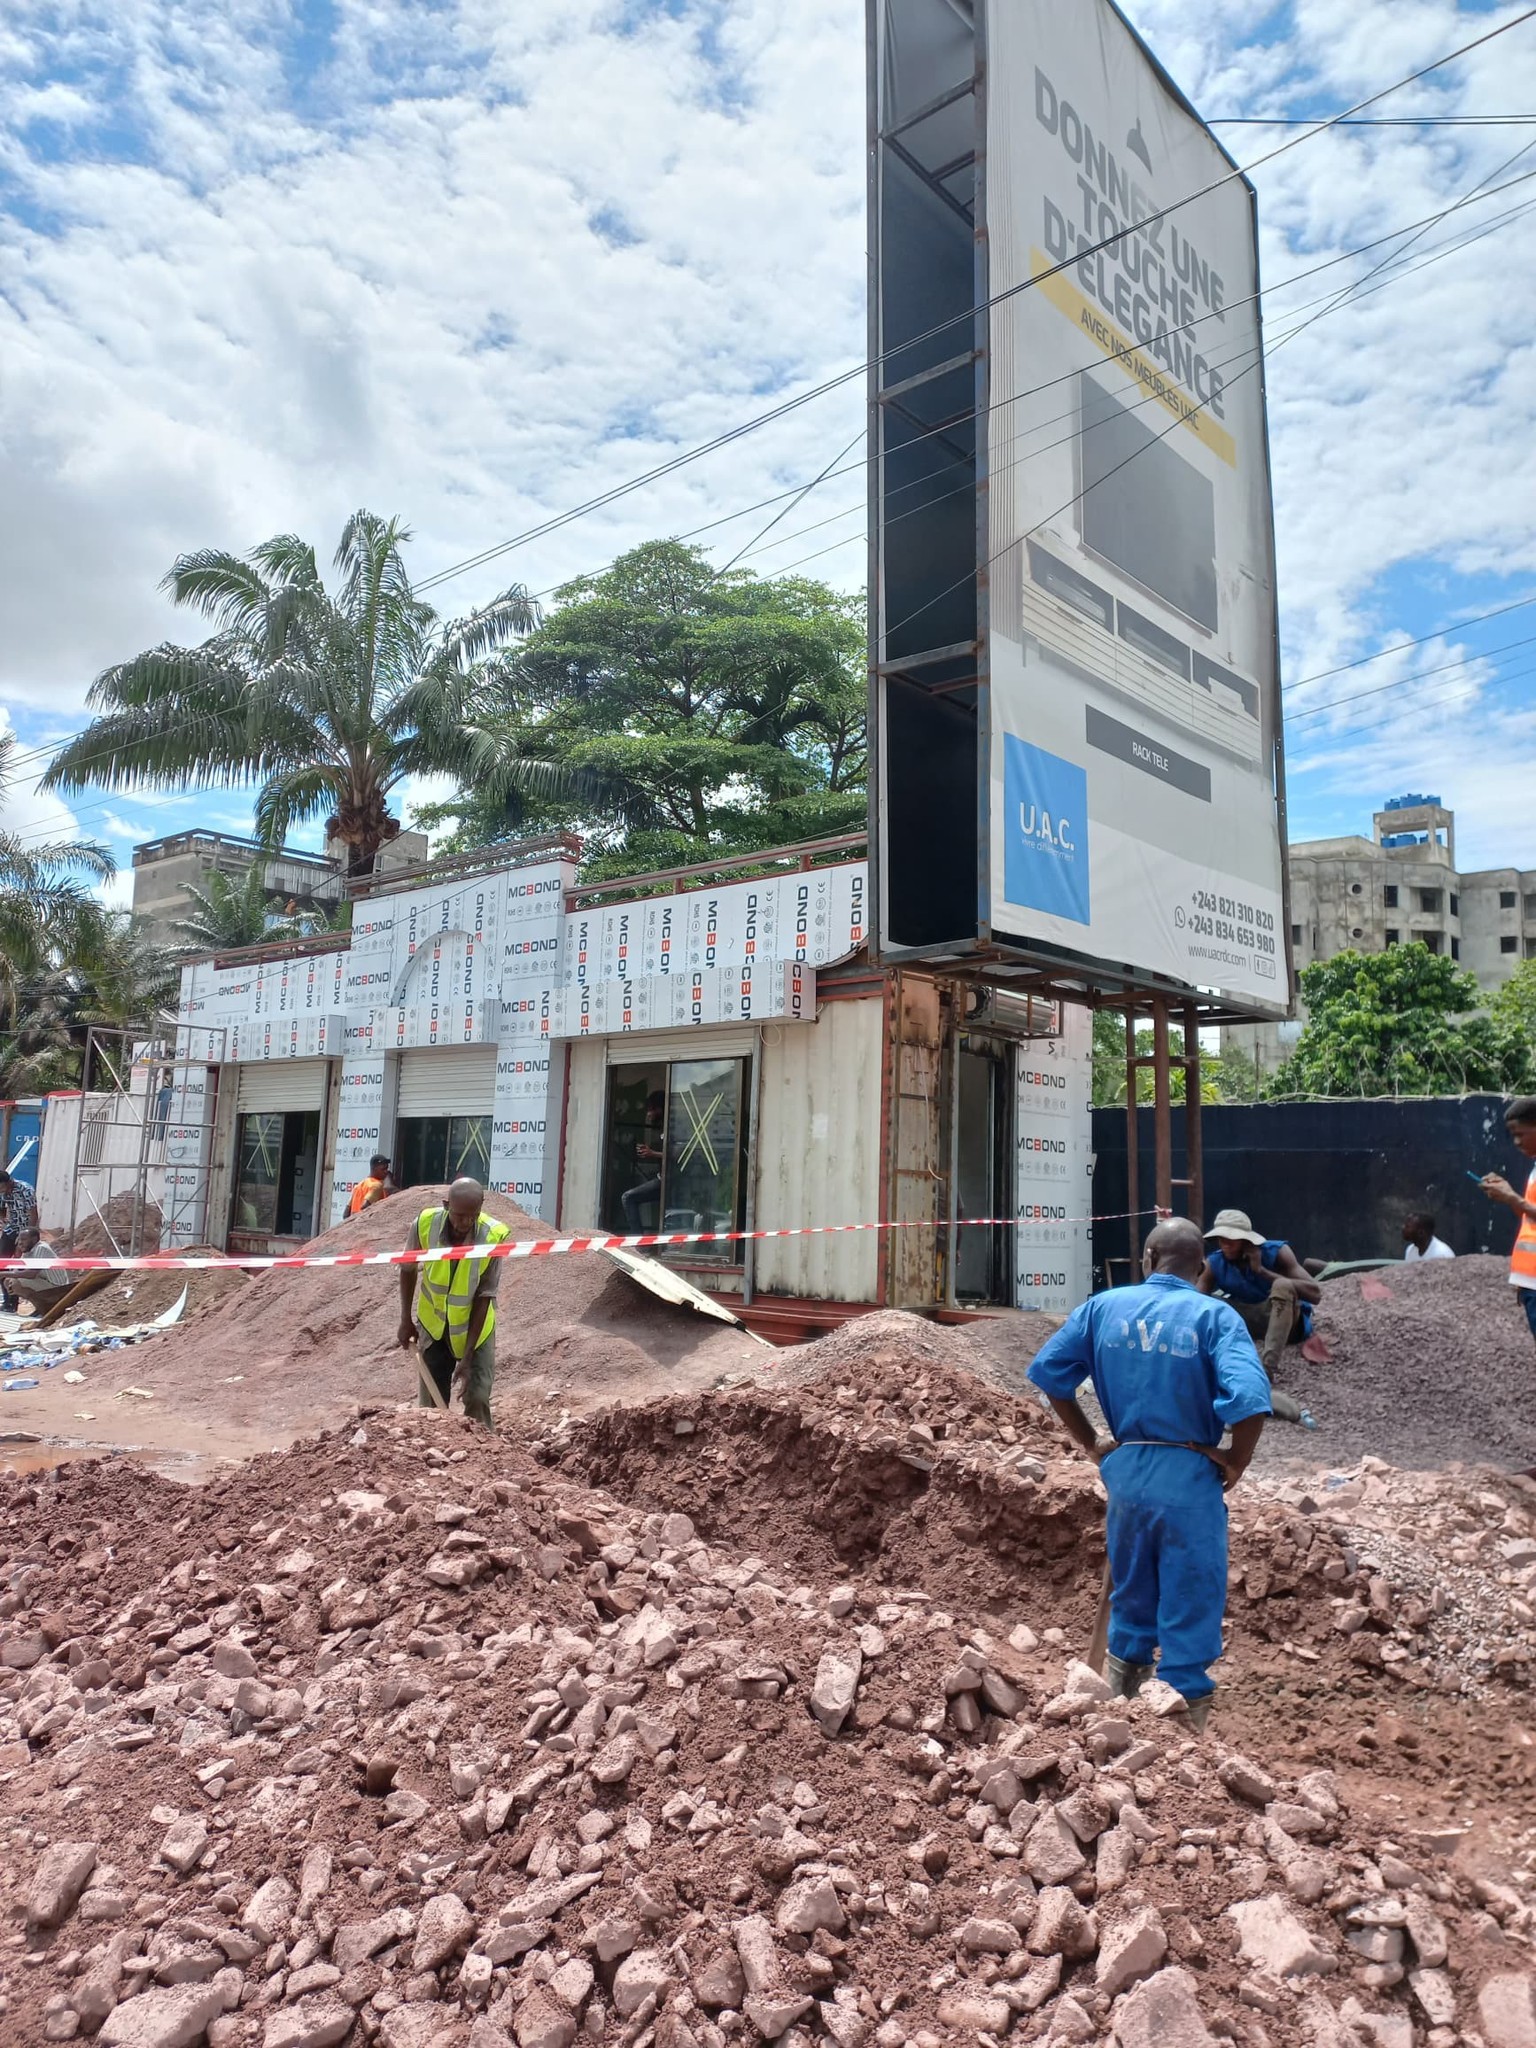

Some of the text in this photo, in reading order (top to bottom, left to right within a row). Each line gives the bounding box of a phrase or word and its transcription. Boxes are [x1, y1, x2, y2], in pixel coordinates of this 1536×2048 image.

[1035, 65, 1225, 324] DONNEZ UNE
[1077, 172, 1197, 343] TOUCHE
[1081, 307, 1200, 431] AVEC NOS MEUBLES UAC
[1132, 741, 1169, 772] RACK TELE
[508, 879, 562, 899] MCBOND
[1192, 890, 1274, 931] +243 821 310 820
[352, 919, 393, 935] MCBOND
[1188, 914, 1275, 955] +243 834 653 980
[505, 938, 558, 957] MCBOND
[1188, 945, 1247, 967] www.uacrdc.com
[347, 972, 389, 987] MCBOND
[397, 1006, 406, 1047] CBO
[430, 1003, 439, 1044] CBO
[464, 1000, 473, 1041] CBO
[497, 1060, 550, 1074] MCBOND
[341, 1074, 382, 1086] MCBOND
[1017, 1070, 1066, 1089] MCBOND
[337, 1127, 379, 1139] MCBOND
[493, 1121, 547, 1134] MCBOND
[1017, 1138, 1066, 1154] MCBOND
[489, 1181, 543, 1195] MCBOND
[1017, 1205, 1066, 1219] MCBOND
[1017, 1273, 1066, 1286] MCBOND
